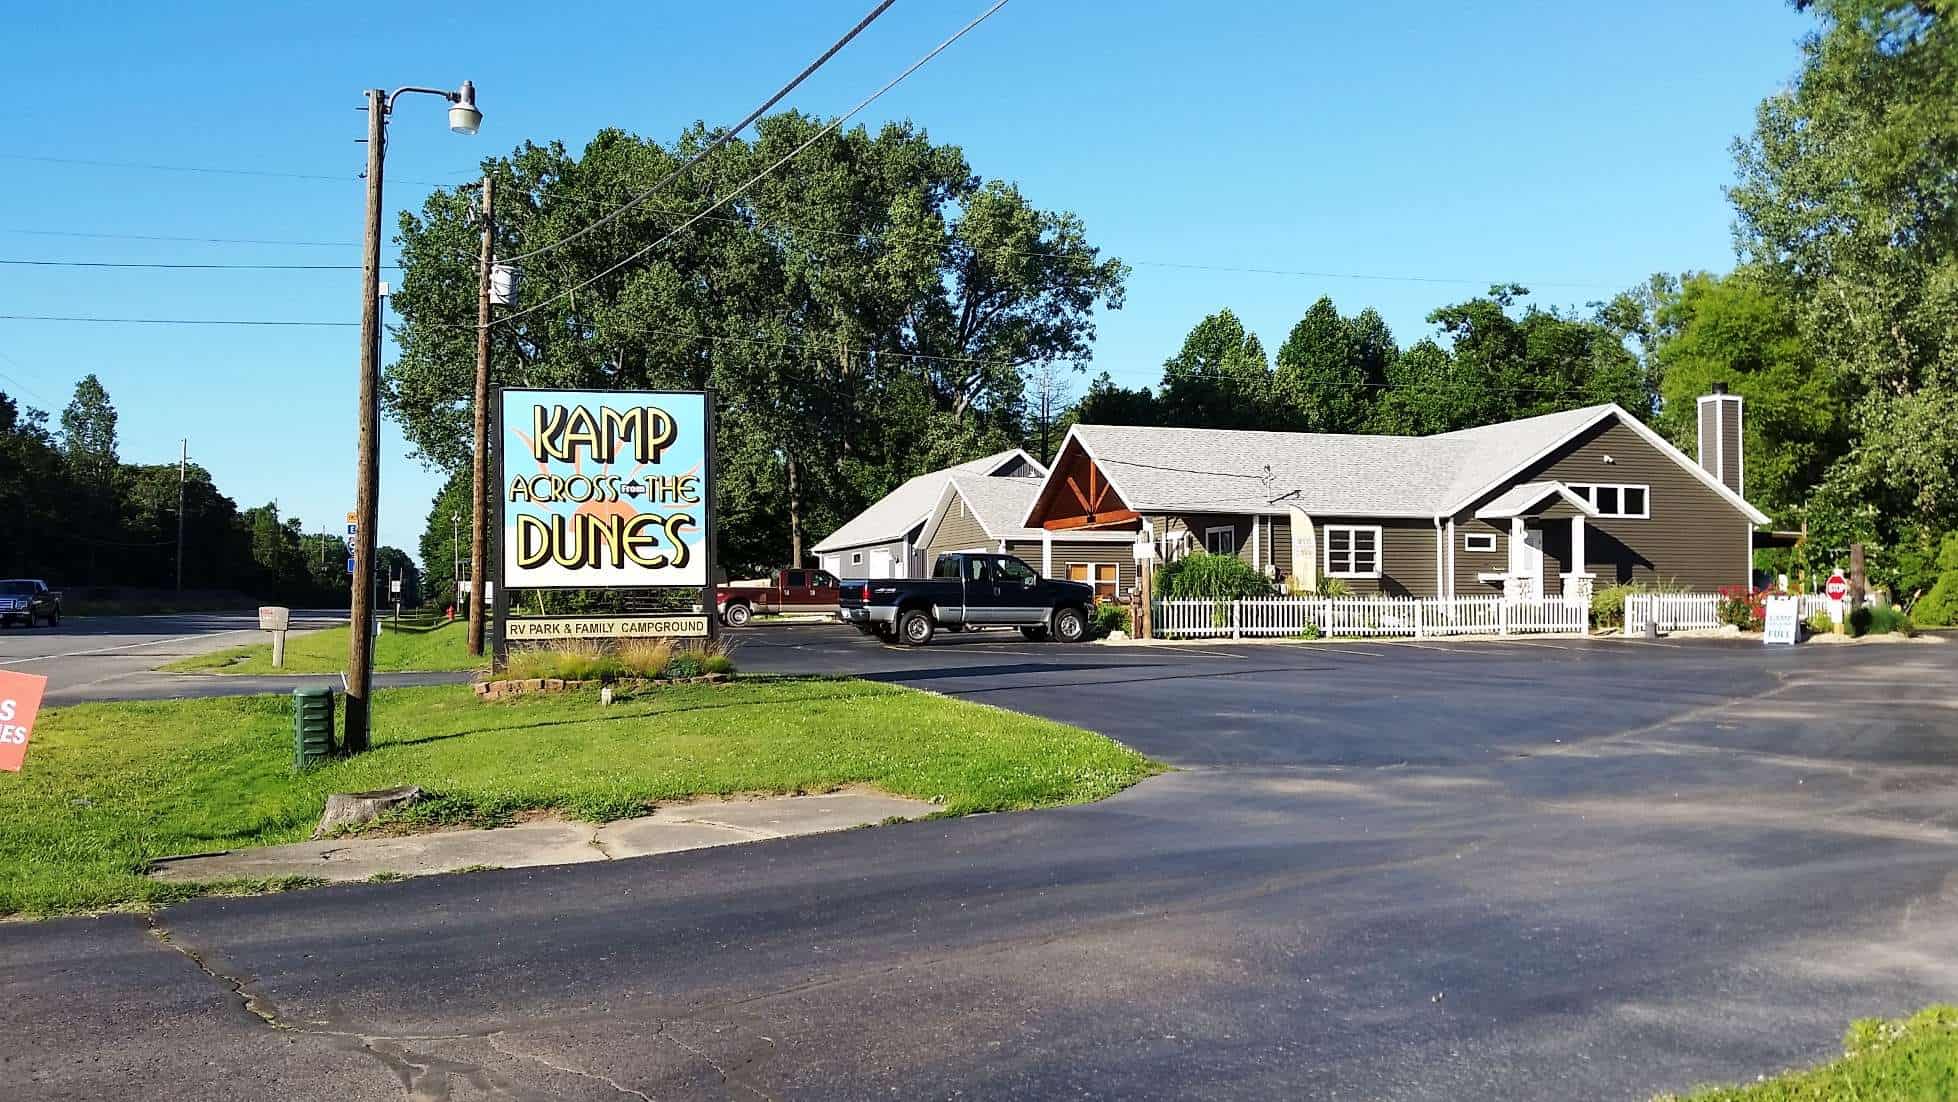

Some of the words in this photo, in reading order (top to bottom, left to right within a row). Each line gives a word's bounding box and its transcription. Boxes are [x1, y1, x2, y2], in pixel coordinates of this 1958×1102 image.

[533, 404, 678, 464] KAMP
[509, 474, 621, 503] ACROSS
[621, 484, 646, 493] From
[644, 474, 700, 503] THE
[516, 512, 696, 569] DUNES
[510, 624, 525, 635] RV
[529, 623, 560, 634] PARK
[564, 623, 572, 634] &
[575, 622, 615, 634] FAMILY
[621, 621, 704, 633] CAMPGROUND
[0, 724, 27, 744] ES
